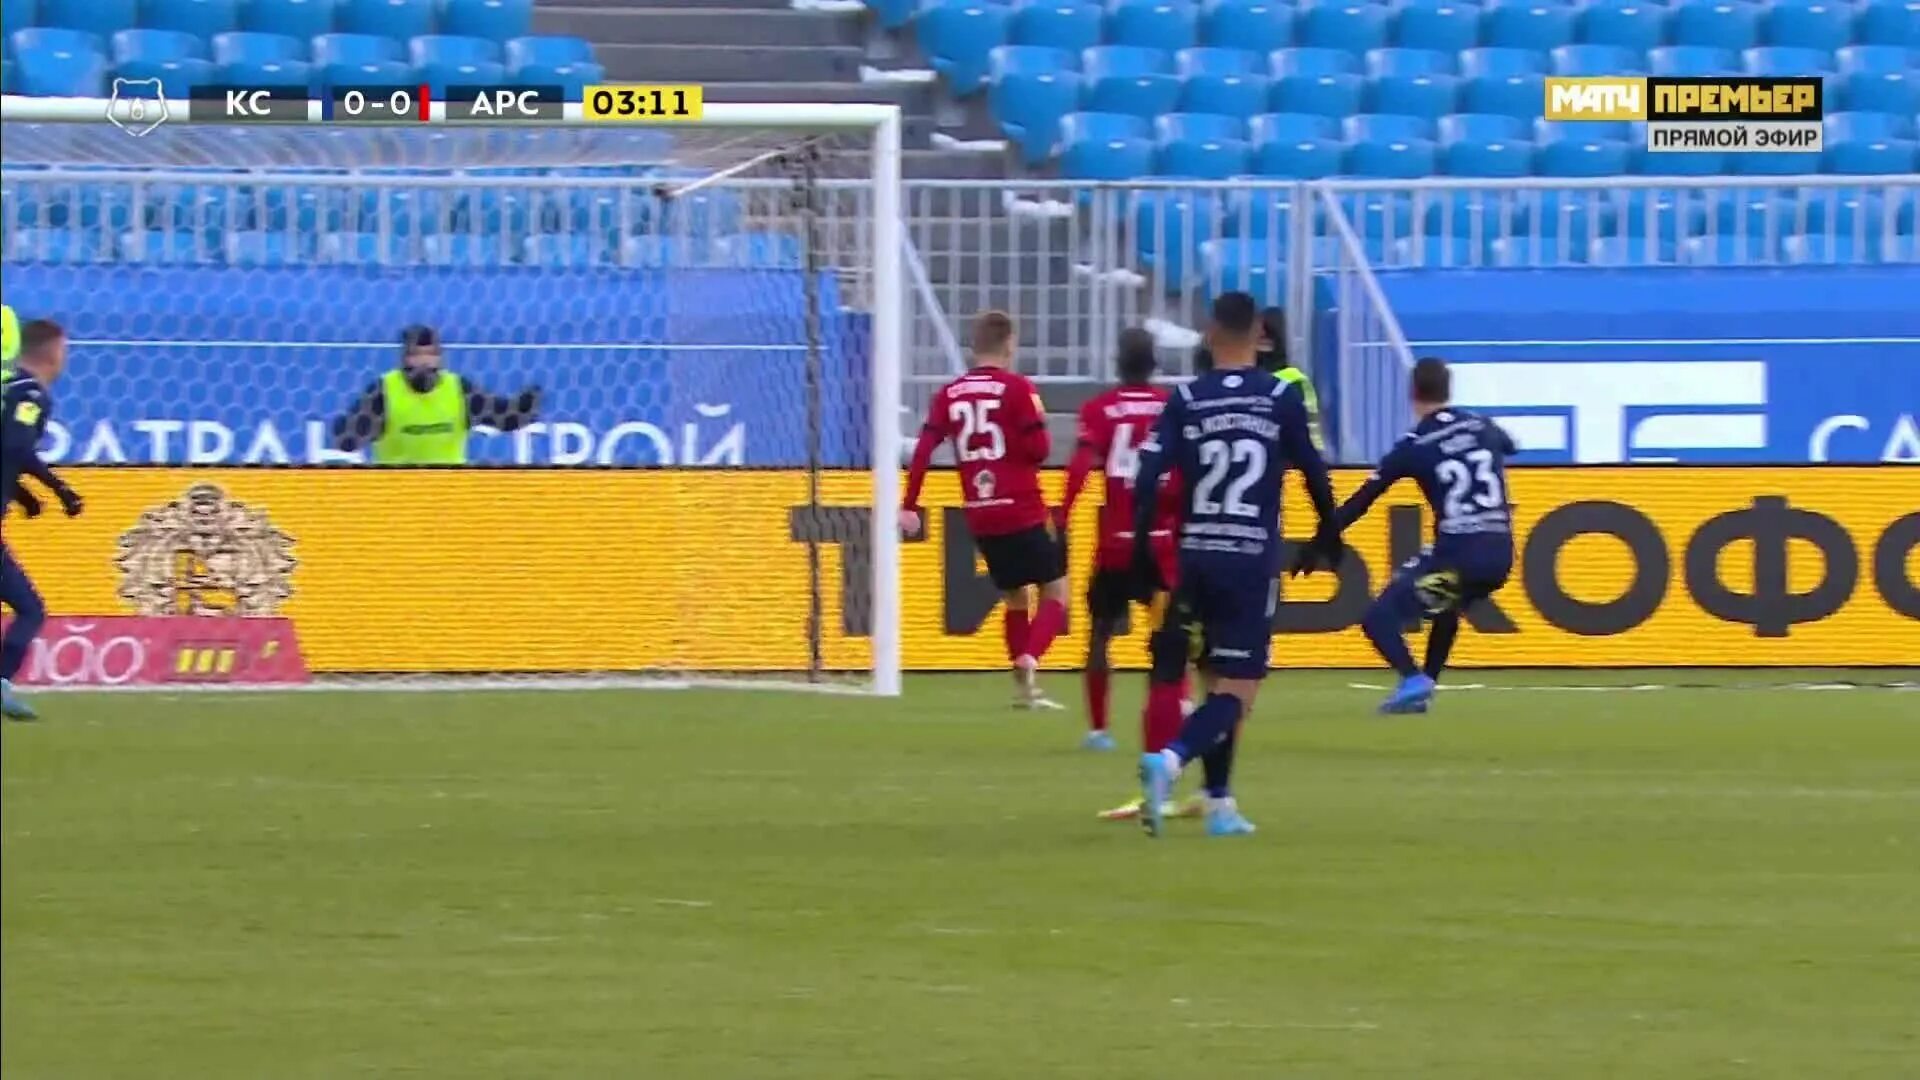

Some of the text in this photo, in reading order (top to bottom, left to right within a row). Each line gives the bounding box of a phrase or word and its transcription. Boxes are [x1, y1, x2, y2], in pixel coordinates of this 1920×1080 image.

[948, 399, 1007, 463] 25
[1192, 438, 1268, 518] 22
[1434, 448, 1503, 520] 23
